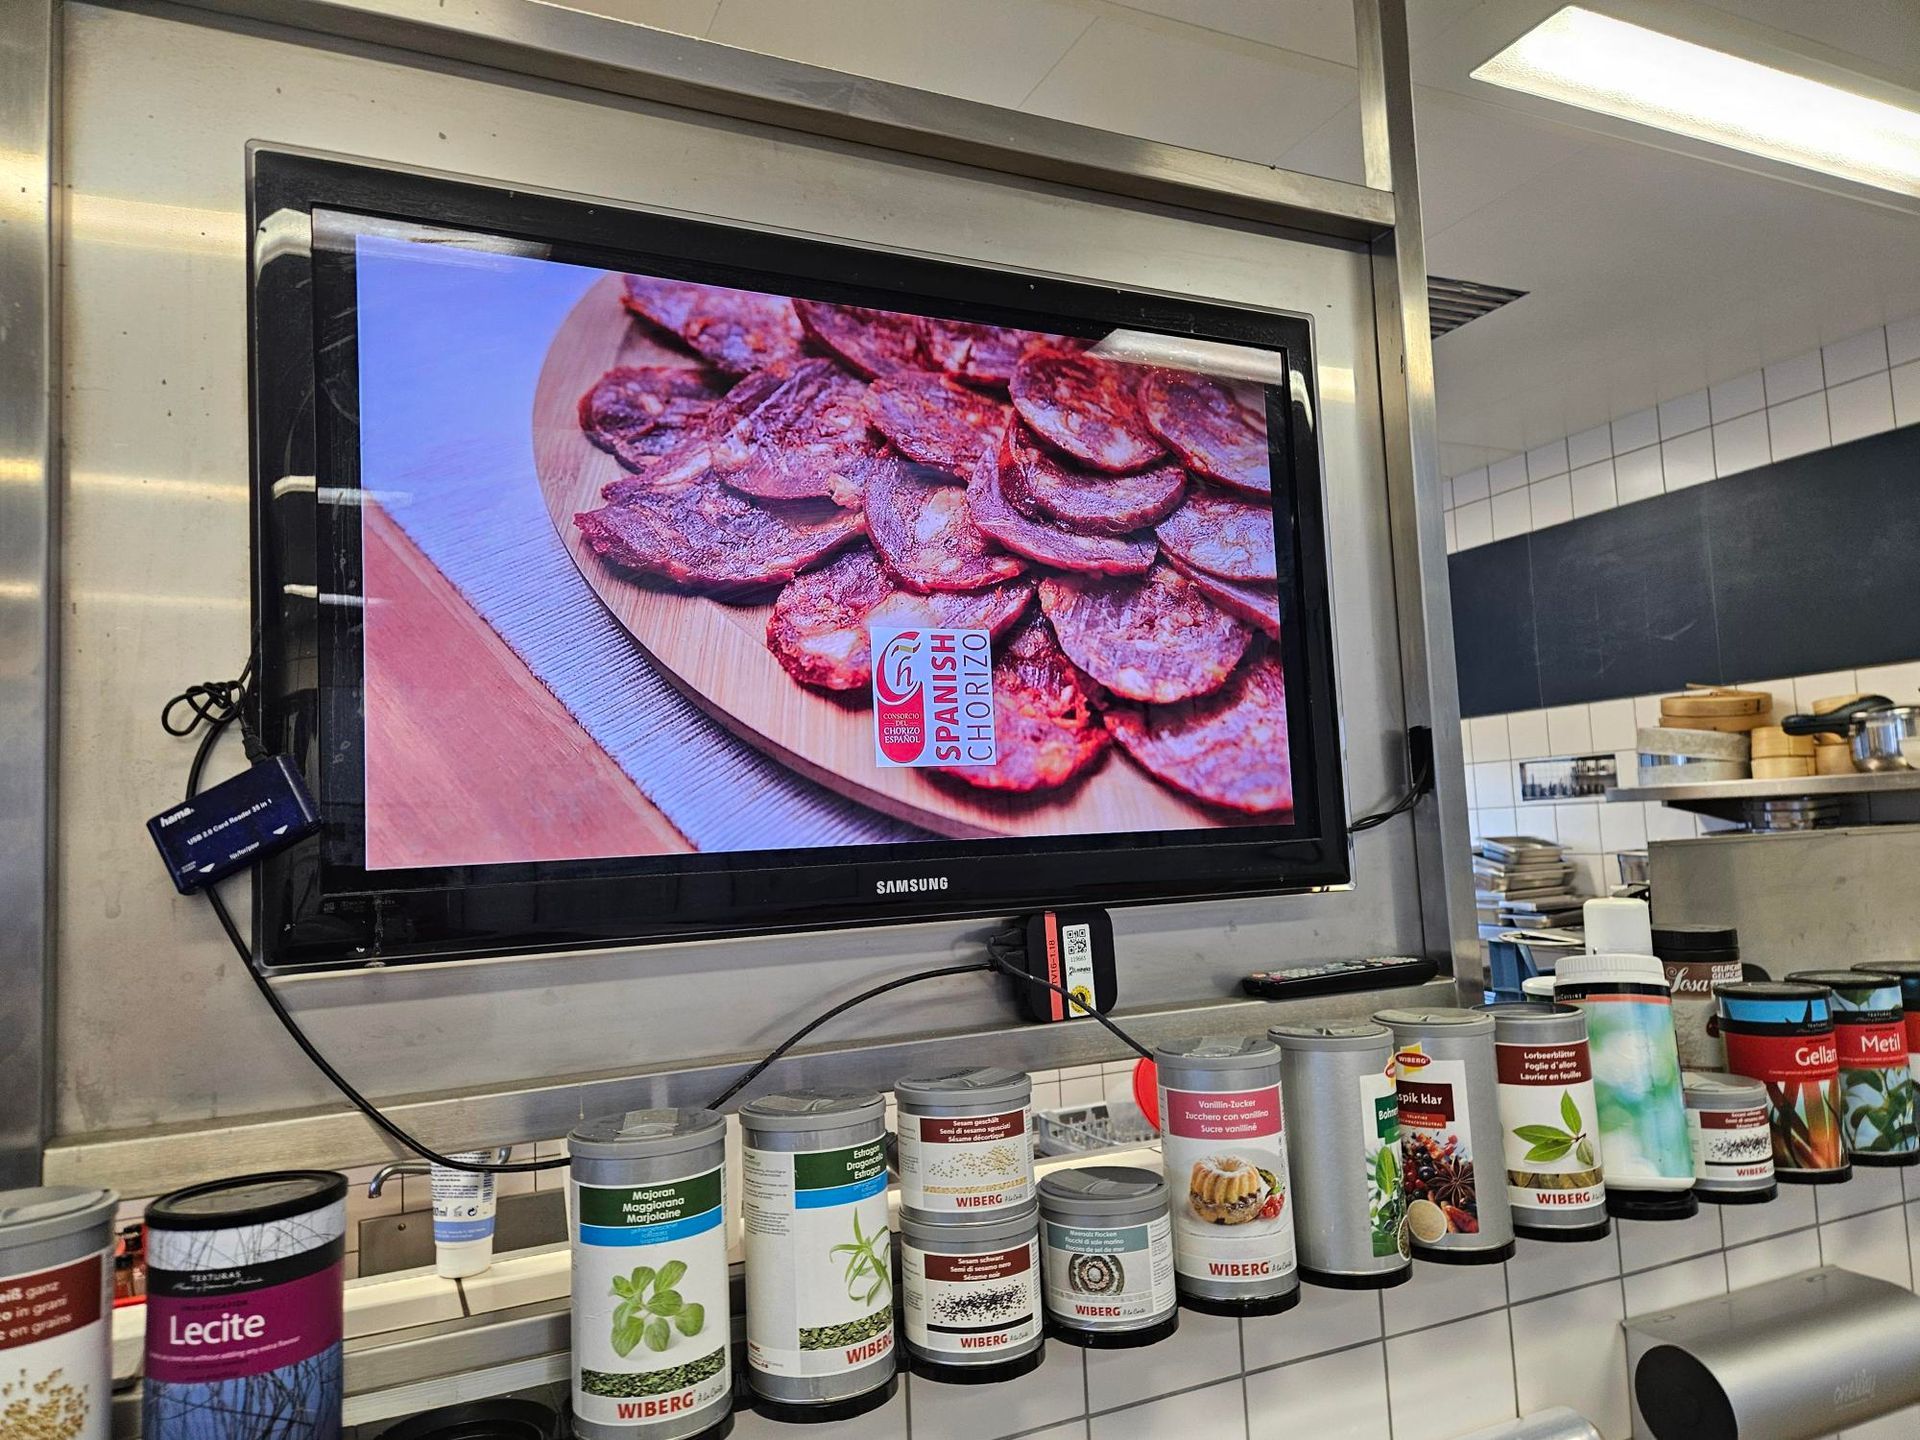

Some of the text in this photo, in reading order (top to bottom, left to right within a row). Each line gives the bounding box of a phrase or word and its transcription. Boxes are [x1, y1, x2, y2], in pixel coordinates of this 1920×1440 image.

[930, 634, 961, 761] SPANISH
[962, 634, 993, 761] CHORIZO
[884, 727, 920, 735] CHORIZO
[884, 735, 921, 744] ESPAÑOL
[187, 833, 203, 846] USB
[212, 820, 229, 832] Card
[228, 809, 252, 824] Reader
[876, 877, 949, 895] SAMSUNG
[1666, 966, 1710, 993] Sosa
[1860, 1033, 1901, 1053] Metil
[1398, 1056, 1427, 1064] WIBERG
[1524, 1050, 1576, 1060] Lorbeerblätter
[1795, 1046, 1837, 1066] Gellan
[1525, 1062, 1549, 1071] Foglie
[1560, 1071, 1582, 1080] feuilles
[1198, 1100, 1256, 1109] Vanillin-Zucker
[1398, 1092, 1443, 1105] spik klar
[1185, 1112, 1221, 1121] Zucchero
[1201, 1124, 1223, 1133] Sucre
[853, 1145, 880, 1159] Estragon
[854, 1165, 881, 1179] Estragon
[632, 1188, 675, 1201] Majoran
[956, 1194, 1003, 1207] WIBERG
[1536, 1192, 1590, 1204] WIBERG
[622, 1198, 685, 1213] Maggiorana
[626, 1209, 681, 1224] Marjolaine
[988, 1271, 1001, 1279] noir
[1208, 1262, 1269, 1276] WIBERG
[25, 1281, 60, 1300] ganz
[0, 1294, 68, 1322] o in grani
[1075, 1305, 1120, 1316] WIBERG
[9, 1326, 29, 1338] en
[31, 1313, 72, 1335] grains
[170, 1312, 266, 1345] Lecite
[960, 1334, 1008, 1348] WIBERG
[617, 1392, 694, 1419] WIBERG
